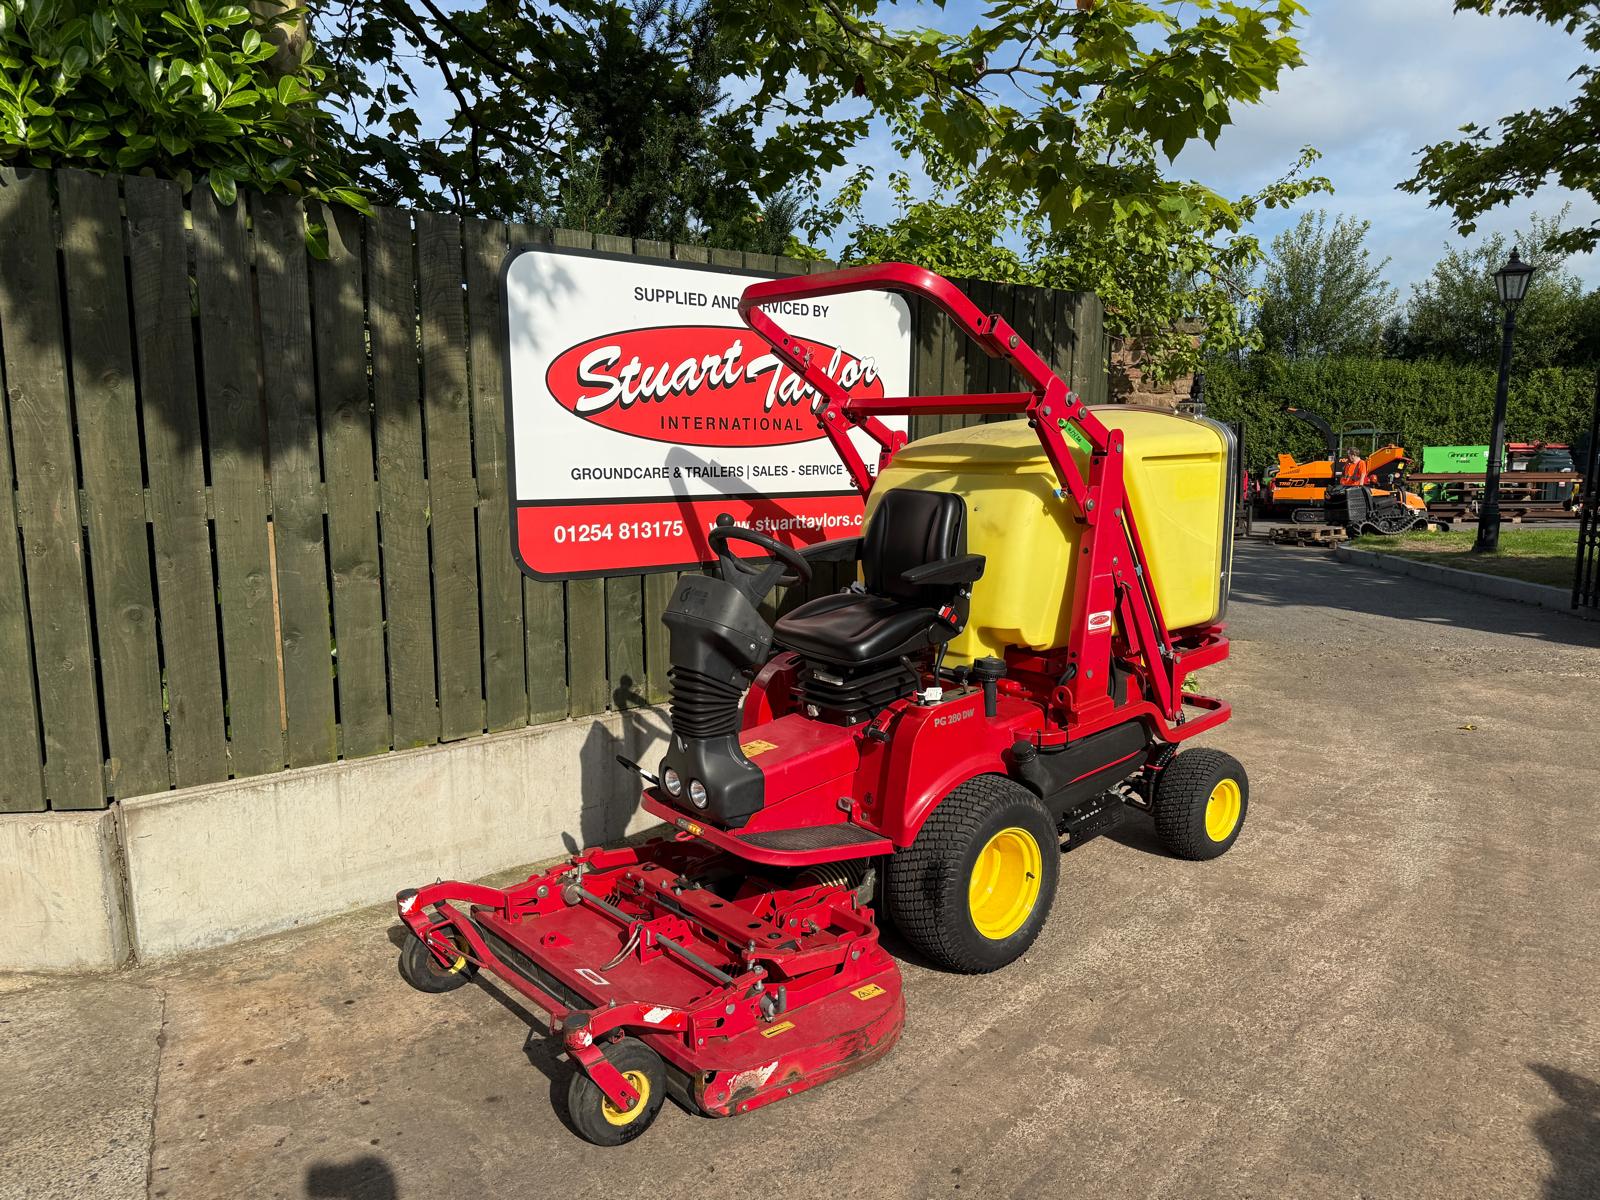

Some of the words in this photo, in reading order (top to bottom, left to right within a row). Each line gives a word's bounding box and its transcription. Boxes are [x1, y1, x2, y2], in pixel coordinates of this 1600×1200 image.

[634, 287, 707, 307] SUPPLIED
[711, 295, 739, 309] AND
[762, 302, 809, 316] RVICED
[813, 305, 829, 317] BY
[573, 339, 745, 418] Stuart
[660, 415, 803, 431] INTERNATIONAL
[571, 467, 670, 480] GROUNDCARE
[673, 466, 682, 478] &
[685, 466, 744, 478] TRAILERS
[752, 465, 788, 477] SALES
[798, 464, 843, 475] SERVICE
[554, 523, 613, 543] 01254
[618, 520, 683, 540] 813175
[934, 716, 947, 728] PG
[948, 712, 961, 725] 280
